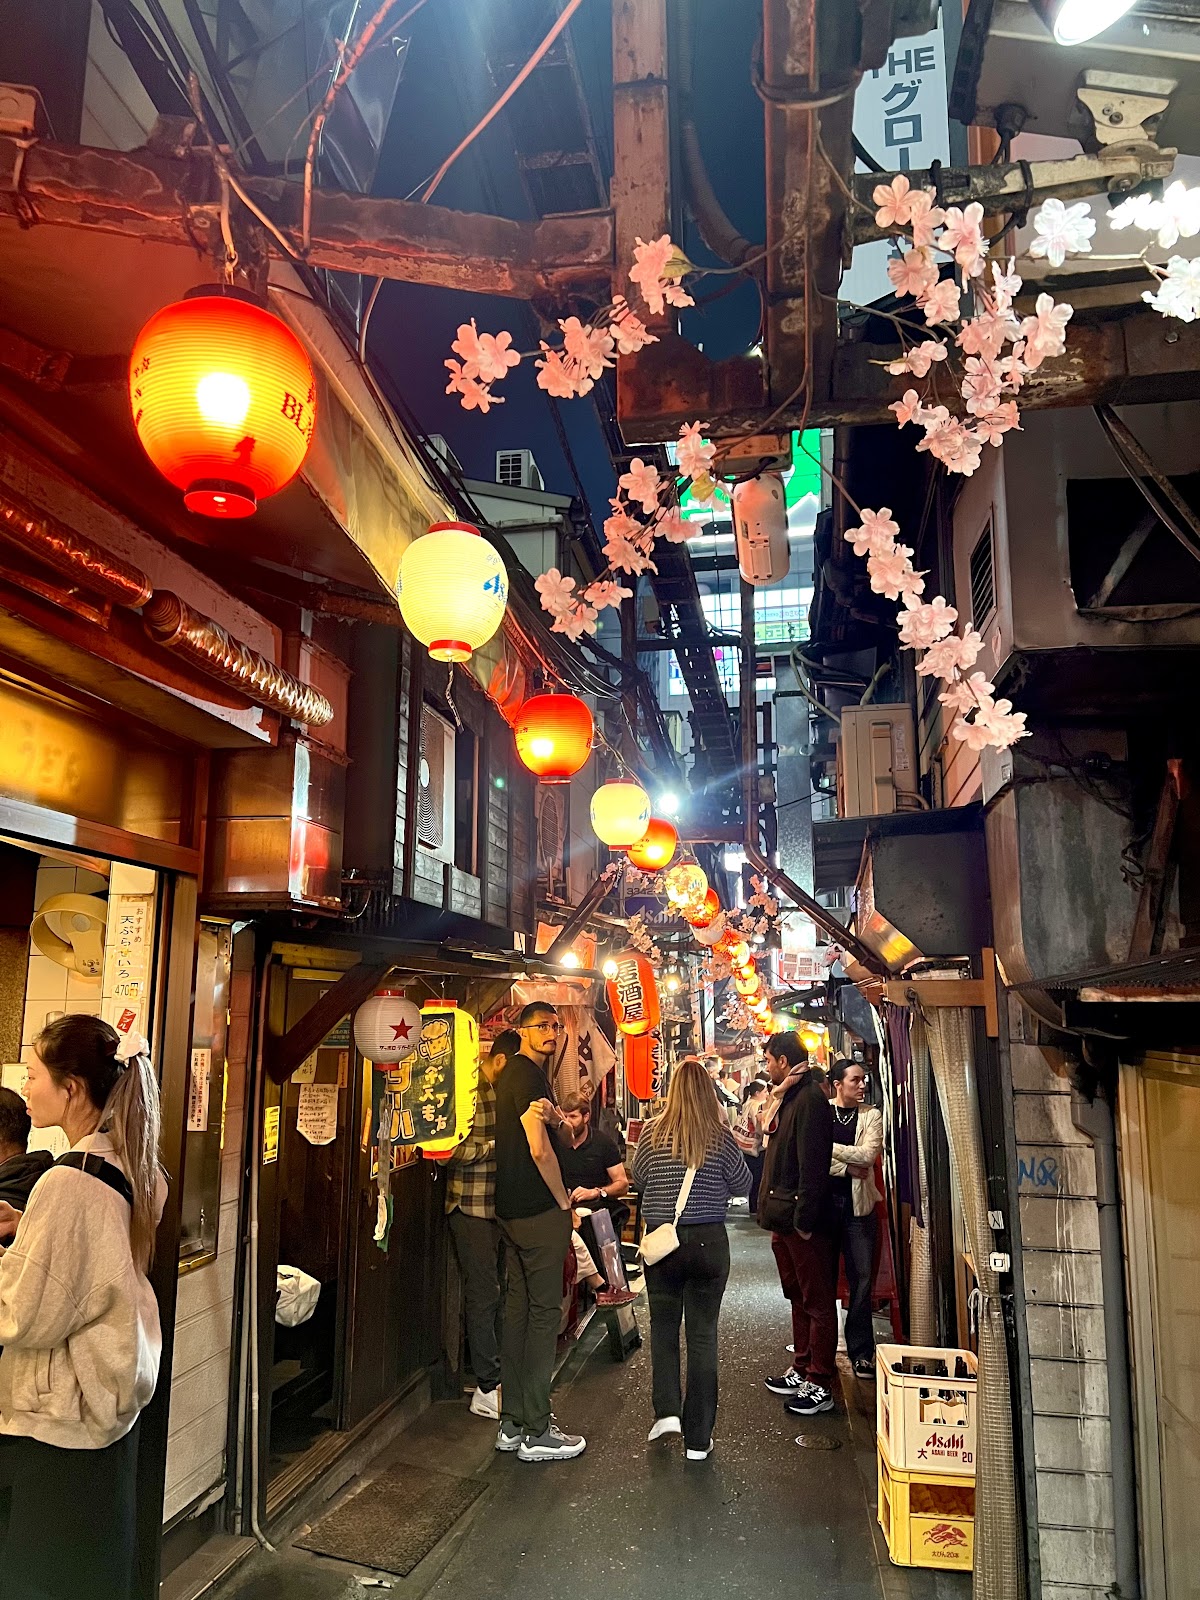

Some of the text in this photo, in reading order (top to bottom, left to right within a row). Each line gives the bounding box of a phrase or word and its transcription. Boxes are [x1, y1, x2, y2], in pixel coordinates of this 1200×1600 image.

[872, 46, 935, 79] HE
[134, 907, 144, 943] おすすめ
[613, 959, 650, 1023] 居酒屋
[925, 1432, 964, 1450] Asahi
[917, 1448, 928, 1460] 大
[947, 1450, 958, 1458] BEER
[961, 1452, 973, 1463] 20
